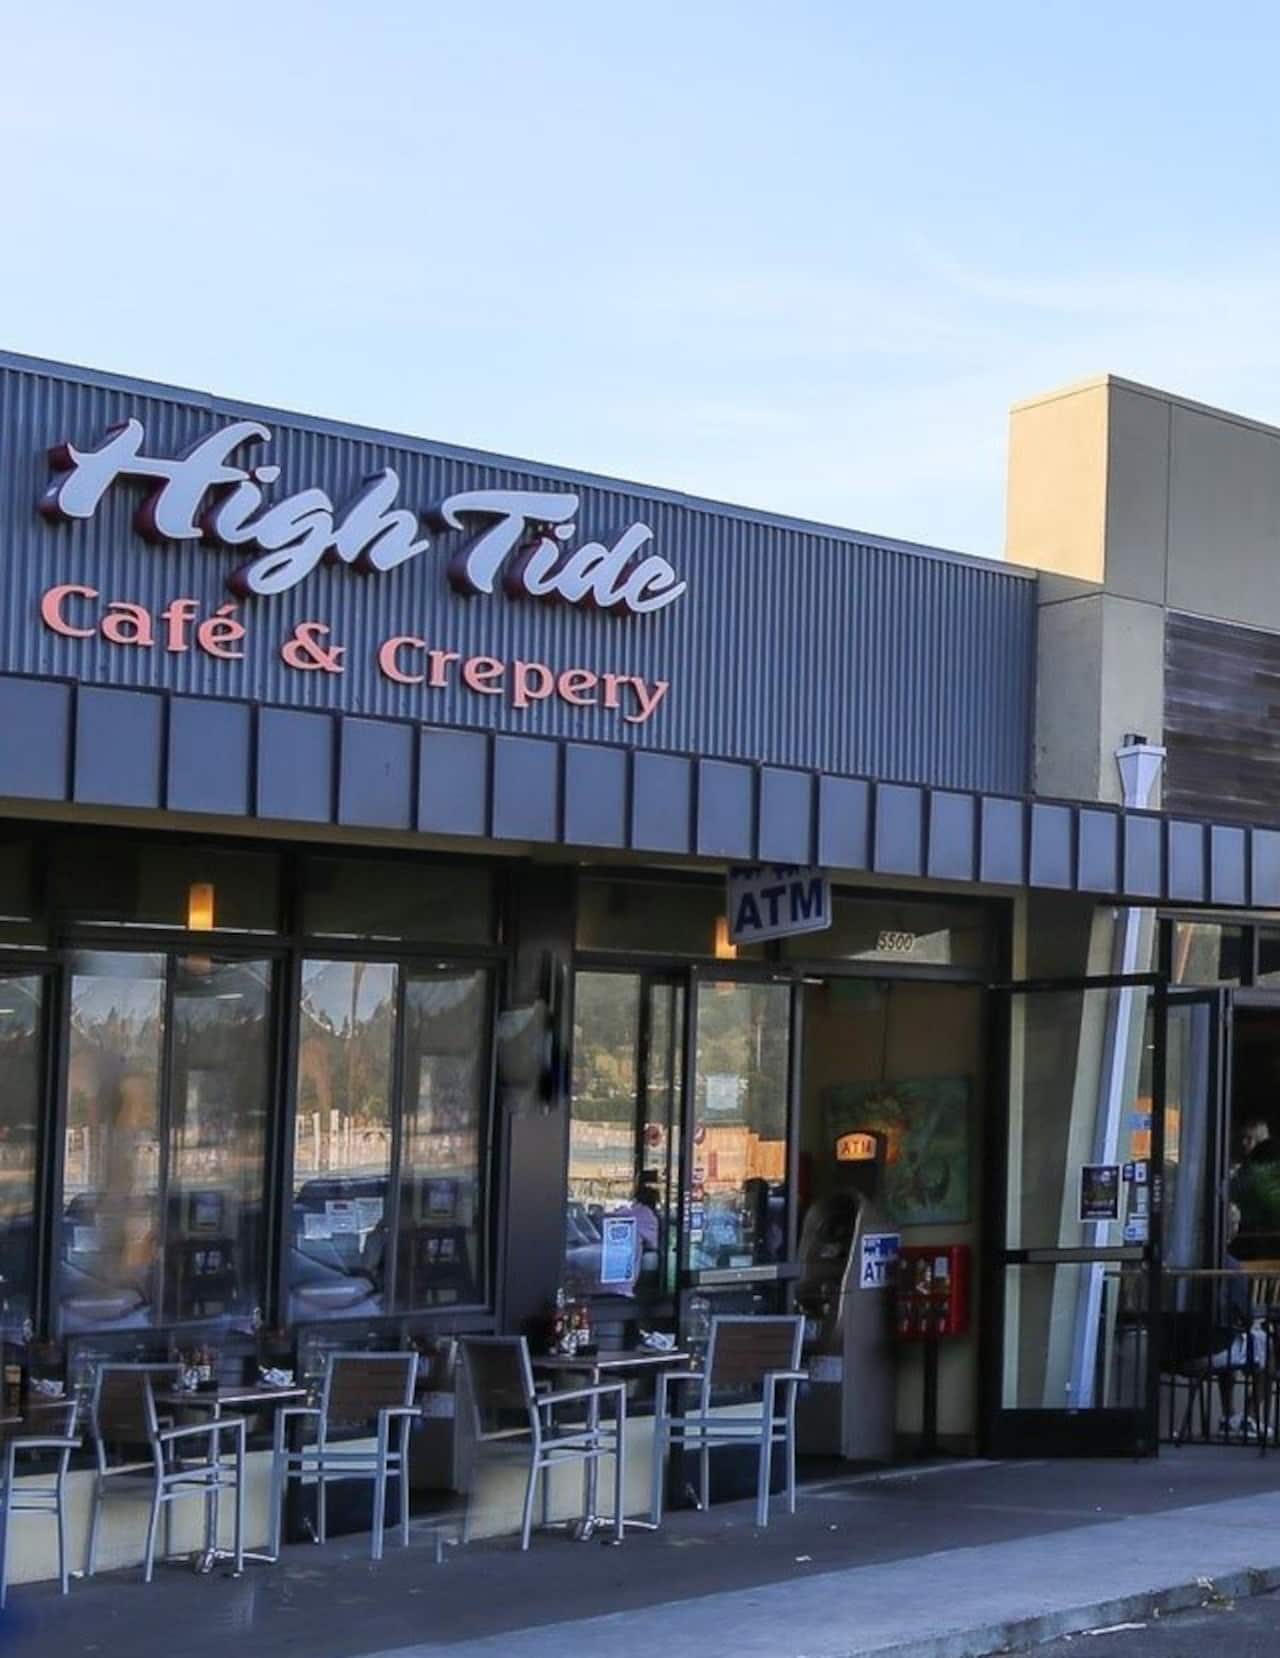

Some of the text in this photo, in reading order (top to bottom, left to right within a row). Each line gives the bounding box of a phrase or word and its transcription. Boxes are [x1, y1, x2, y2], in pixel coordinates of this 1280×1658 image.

[48, 417, 687, 613] High Tide
[40, 583, 671, 724] Café & Crepery
[734, 876, 824, 933] ATM
[877, 934, 914, 952] 5500
